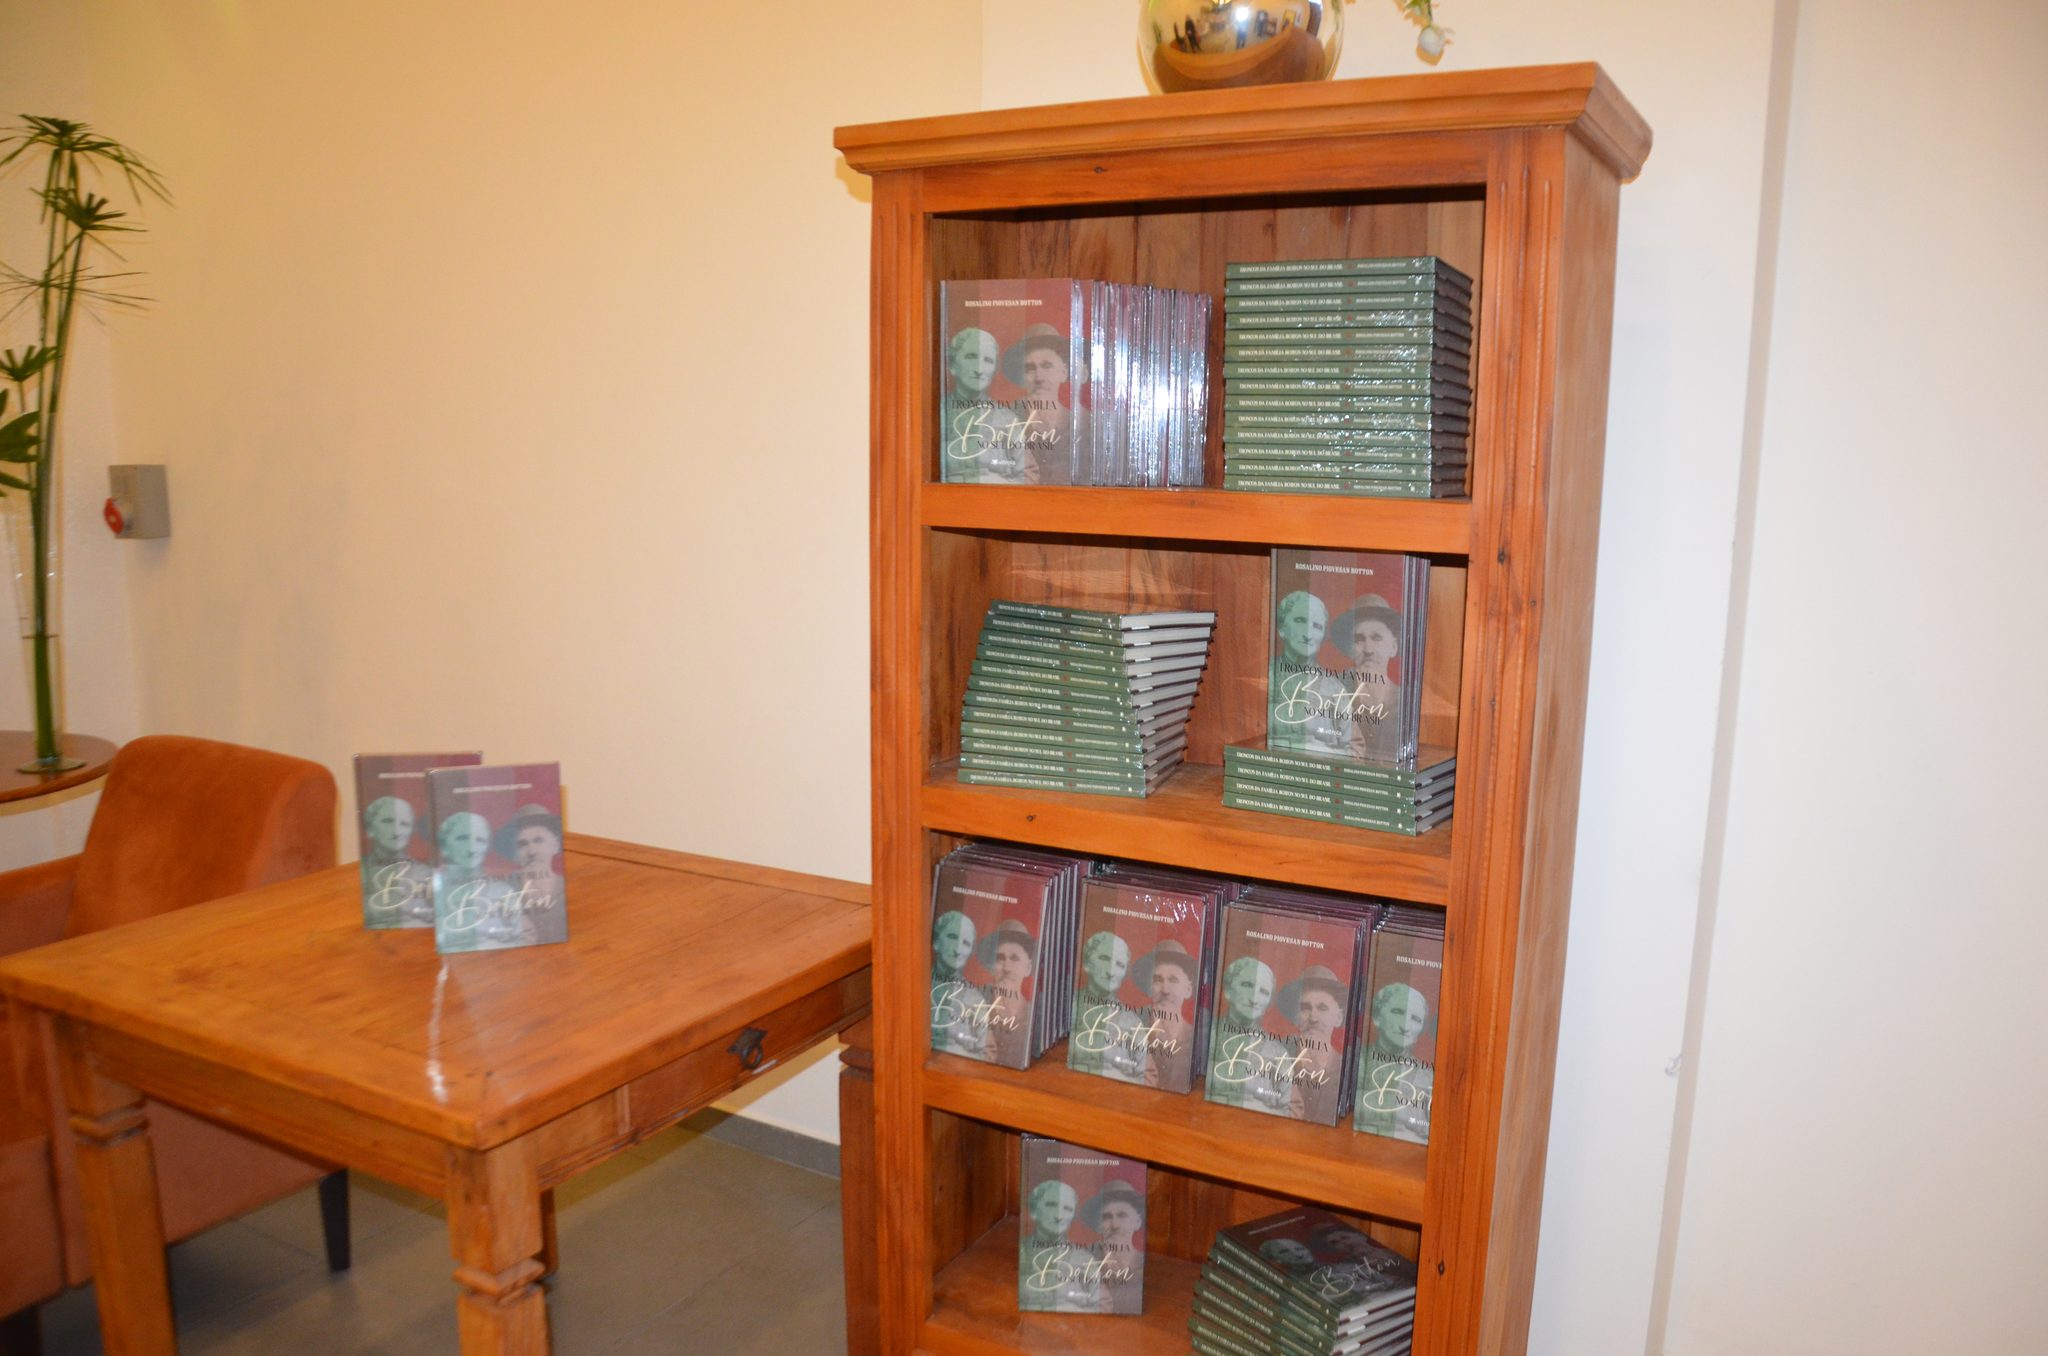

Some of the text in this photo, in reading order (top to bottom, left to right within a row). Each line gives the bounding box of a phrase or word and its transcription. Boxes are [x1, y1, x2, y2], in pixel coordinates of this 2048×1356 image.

[947, 404, 1061, 460] Botton
[1295, 562, 1374, 575] ROSALINO PIOVESAN BOTTON
[1280, 663, 1322, 676] TRONCOS
[1325, 669, 1339, 679] DA
[1275, 670, 1389, 724] Botton
[1304, 706, 1317, 716] NO
[1246, 930, 1325, 949] ROSALINO PIOVESAN BOTTON
[1396, 955, 1425, 965] ROSALINO
[931, 981, 1020, 1031] Botton
[1075, 1004, 1182, 1052] Botton
[1223, 1023, 1266, 1039] TRONCOS
[1269, 1031, 1282, 1043] DA
[1214, 1032, 1330, 1085] Botton
[1372, 1051, 1435, 1072] TRONCOS DA
[1395, 1095, 1408, 1105] NO
[1026, 1245, 1135, 1292] Botton
